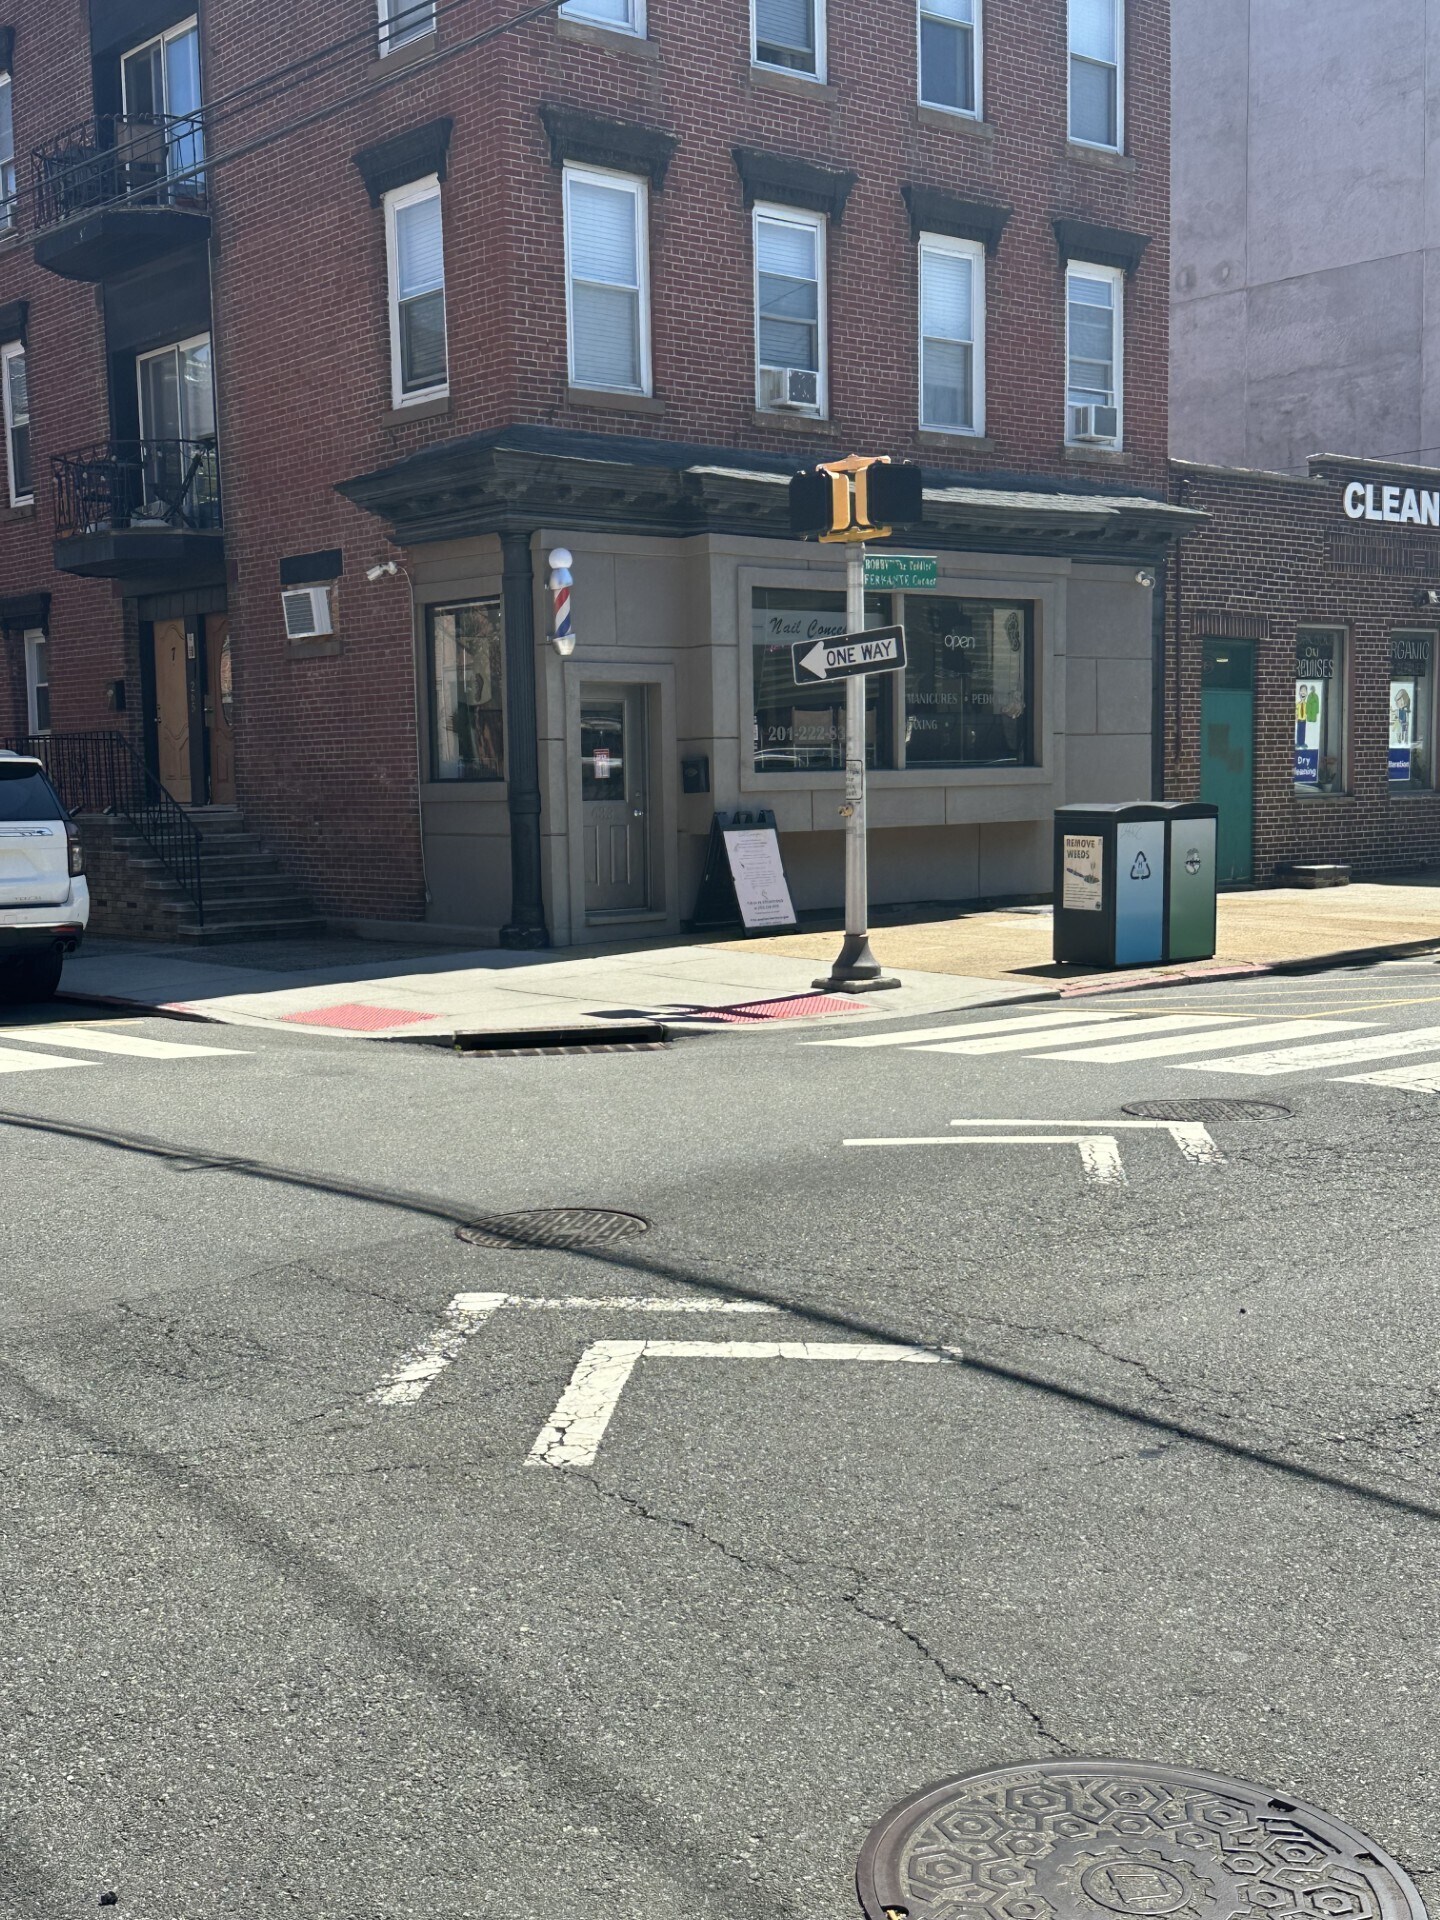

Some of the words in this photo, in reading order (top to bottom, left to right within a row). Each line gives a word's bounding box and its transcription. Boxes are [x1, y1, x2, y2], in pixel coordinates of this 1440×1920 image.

[1343, 481, 1440, 527] CLEAN
[769, 616, 802, 635] Nail
[944, 634, 976, 650] open
[826, 647, 856, 666] ONE
[860, 641, 892, 660] WAY
[1066, 838, 1096, 849] REMOVE
[1066, 849, 1090, 860] WEEDS
